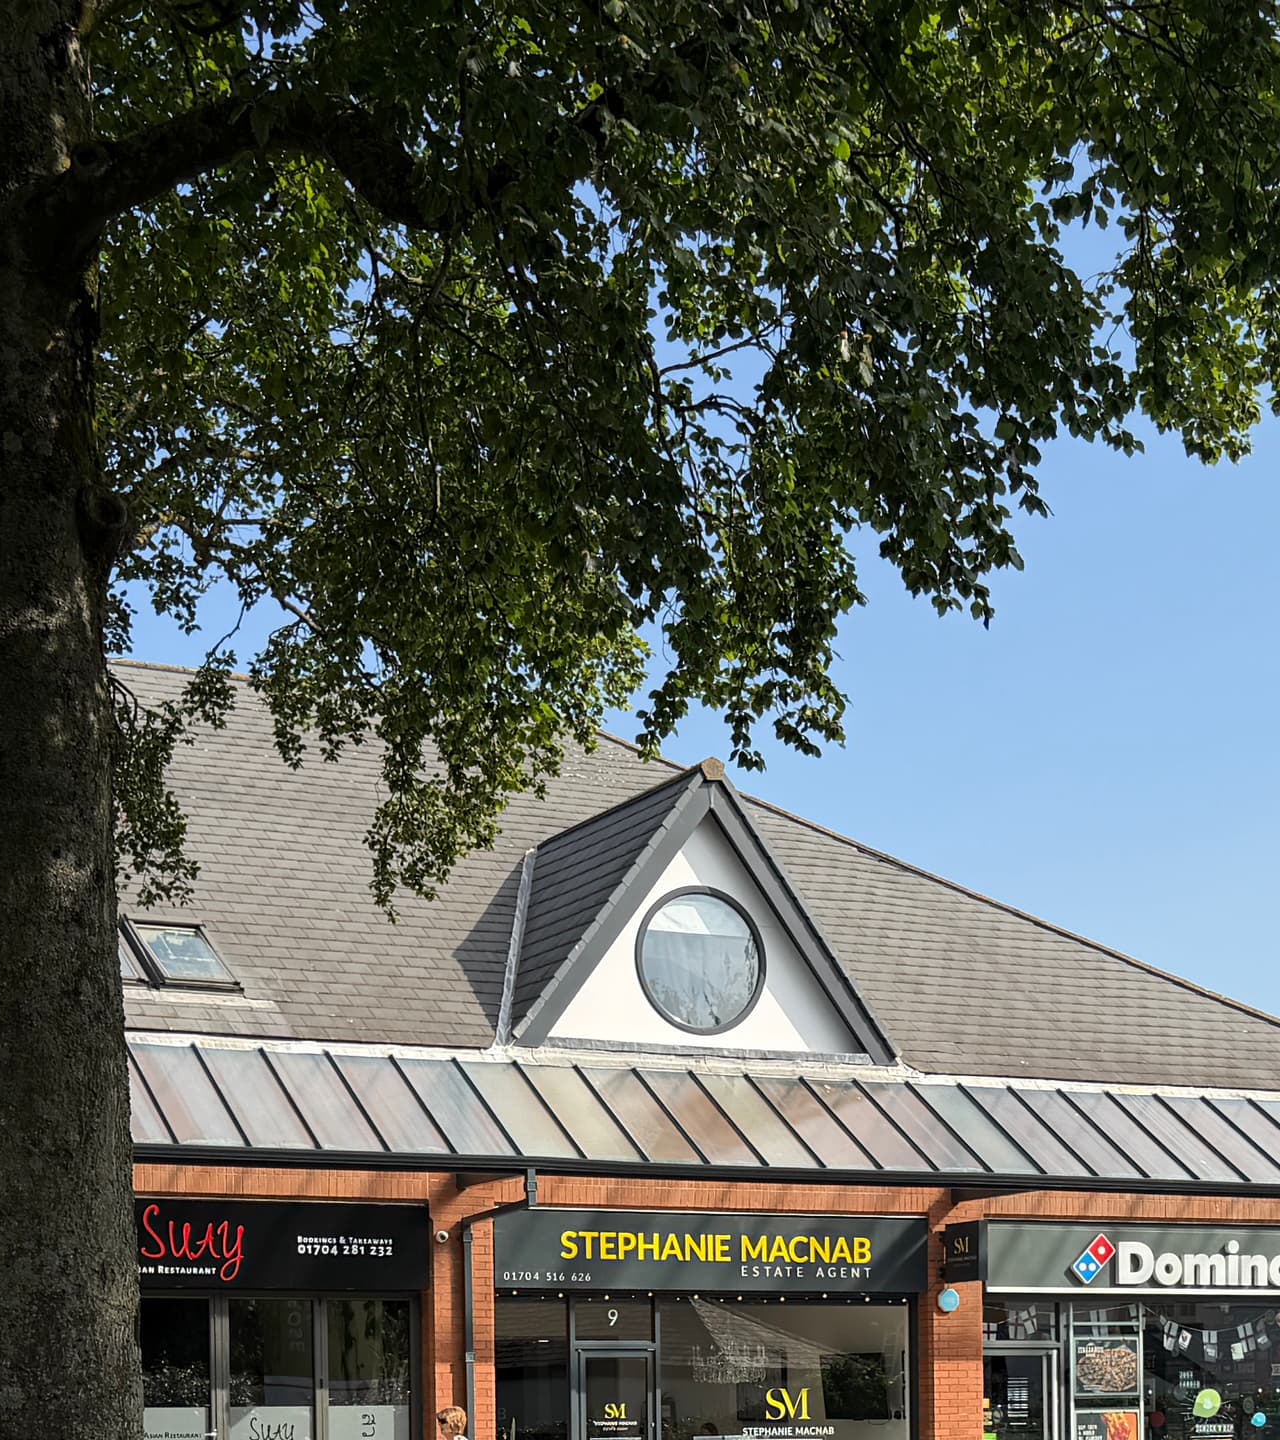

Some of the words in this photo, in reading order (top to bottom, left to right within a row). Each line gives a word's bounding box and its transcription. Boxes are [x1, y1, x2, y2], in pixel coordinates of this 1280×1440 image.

[297, 1244, 338, 1256] 01704
[343, 1245, 365, 1255] 281
[369, 1246, 393, 1257] 232
[560, 1231, 732, 1263] STEPHANIE
[741, 1234, 872, 1265] MACNAB
[157, 1265, 217, 1275] RESTAURANT
[503, 1271, 540, 1281] 01704
[545, 1272, 566, 1282] 516
[571, 1272, 592, 1282] 626
[741, 1265, 805, 1278] ESTATE
[815, 1266, 872, 1279] AGENT
[607, 1308, 619, 1327] 9
[604, 1402, 627, 1419] SM
[765, 1387, 812, 1421] SM
[742, 1427, 793, 1437] STEPHANIE
[795, 1426, 835, 1436] MACNAB
